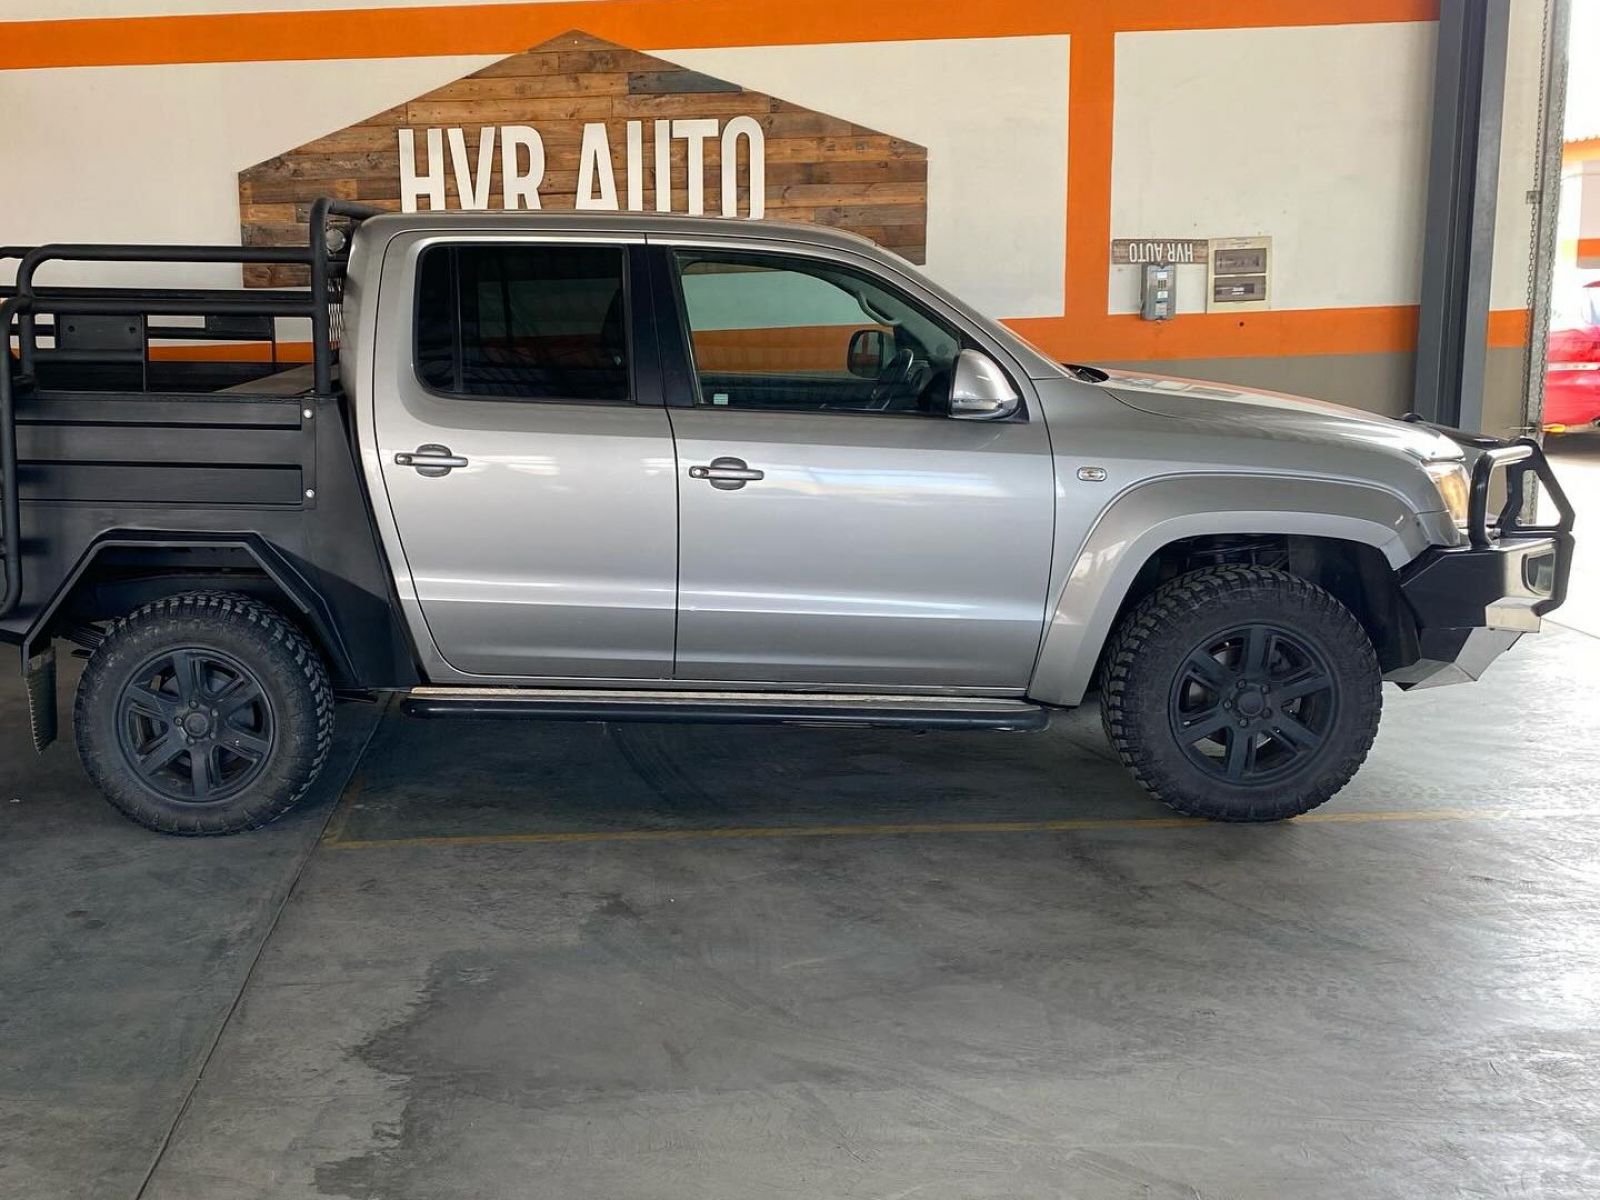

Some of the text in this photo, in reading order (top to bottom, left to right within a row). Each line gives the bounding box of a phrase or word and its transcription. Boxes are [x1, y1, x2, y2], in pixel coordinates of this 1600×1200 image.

[398, 115, 765, 220] HVR AUTO
[1129, 242, 1194, 263] HVR AUTO
